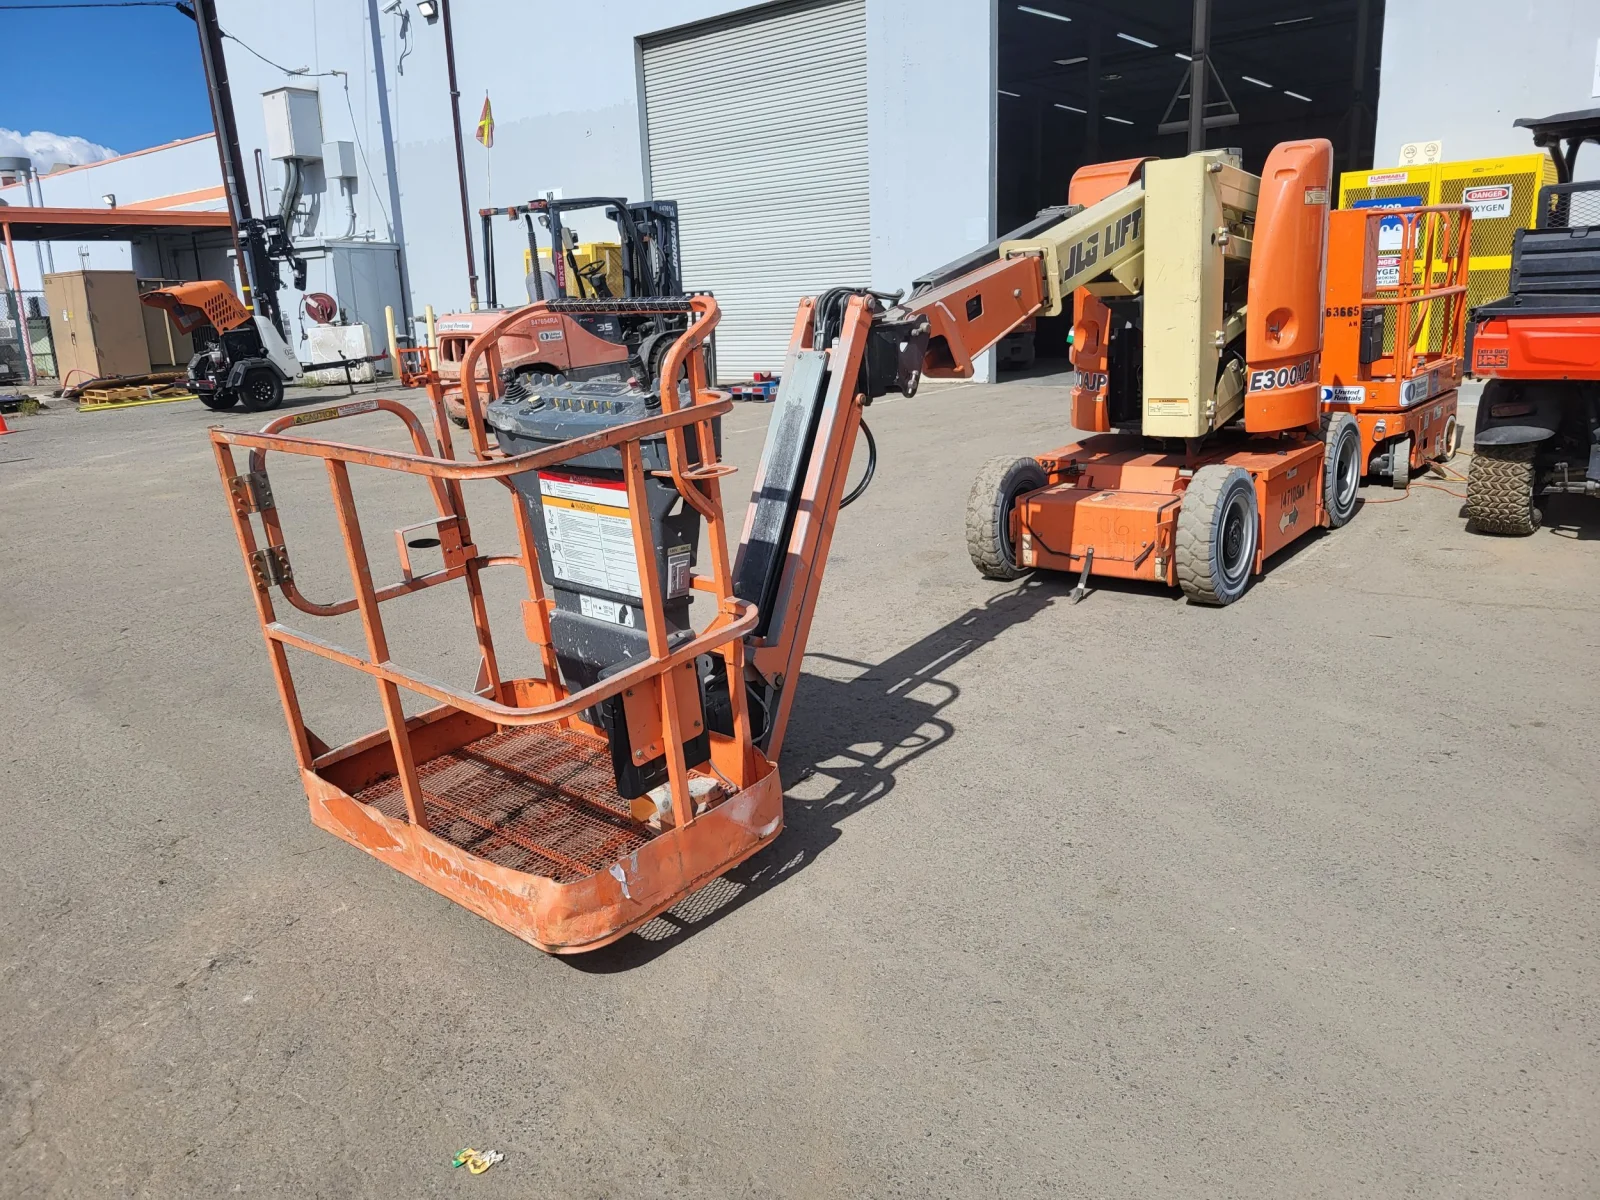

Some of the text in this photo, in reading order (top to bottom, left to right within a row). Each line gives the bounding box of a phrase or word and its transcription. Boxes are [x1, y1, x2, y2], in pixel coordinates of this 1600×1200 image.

[1471, 190, 1503, 199] DANGER
[670, 220, 678, 268] DOOSAN
[1063, 206, 1142, 282] JLG LIFT
[1326, 305, 1360, 318] 63665
[596, 322, 613, 332] 35
[303, 409, 337, 422] CAUTION
[574, 502, 596, 512] WARNING
